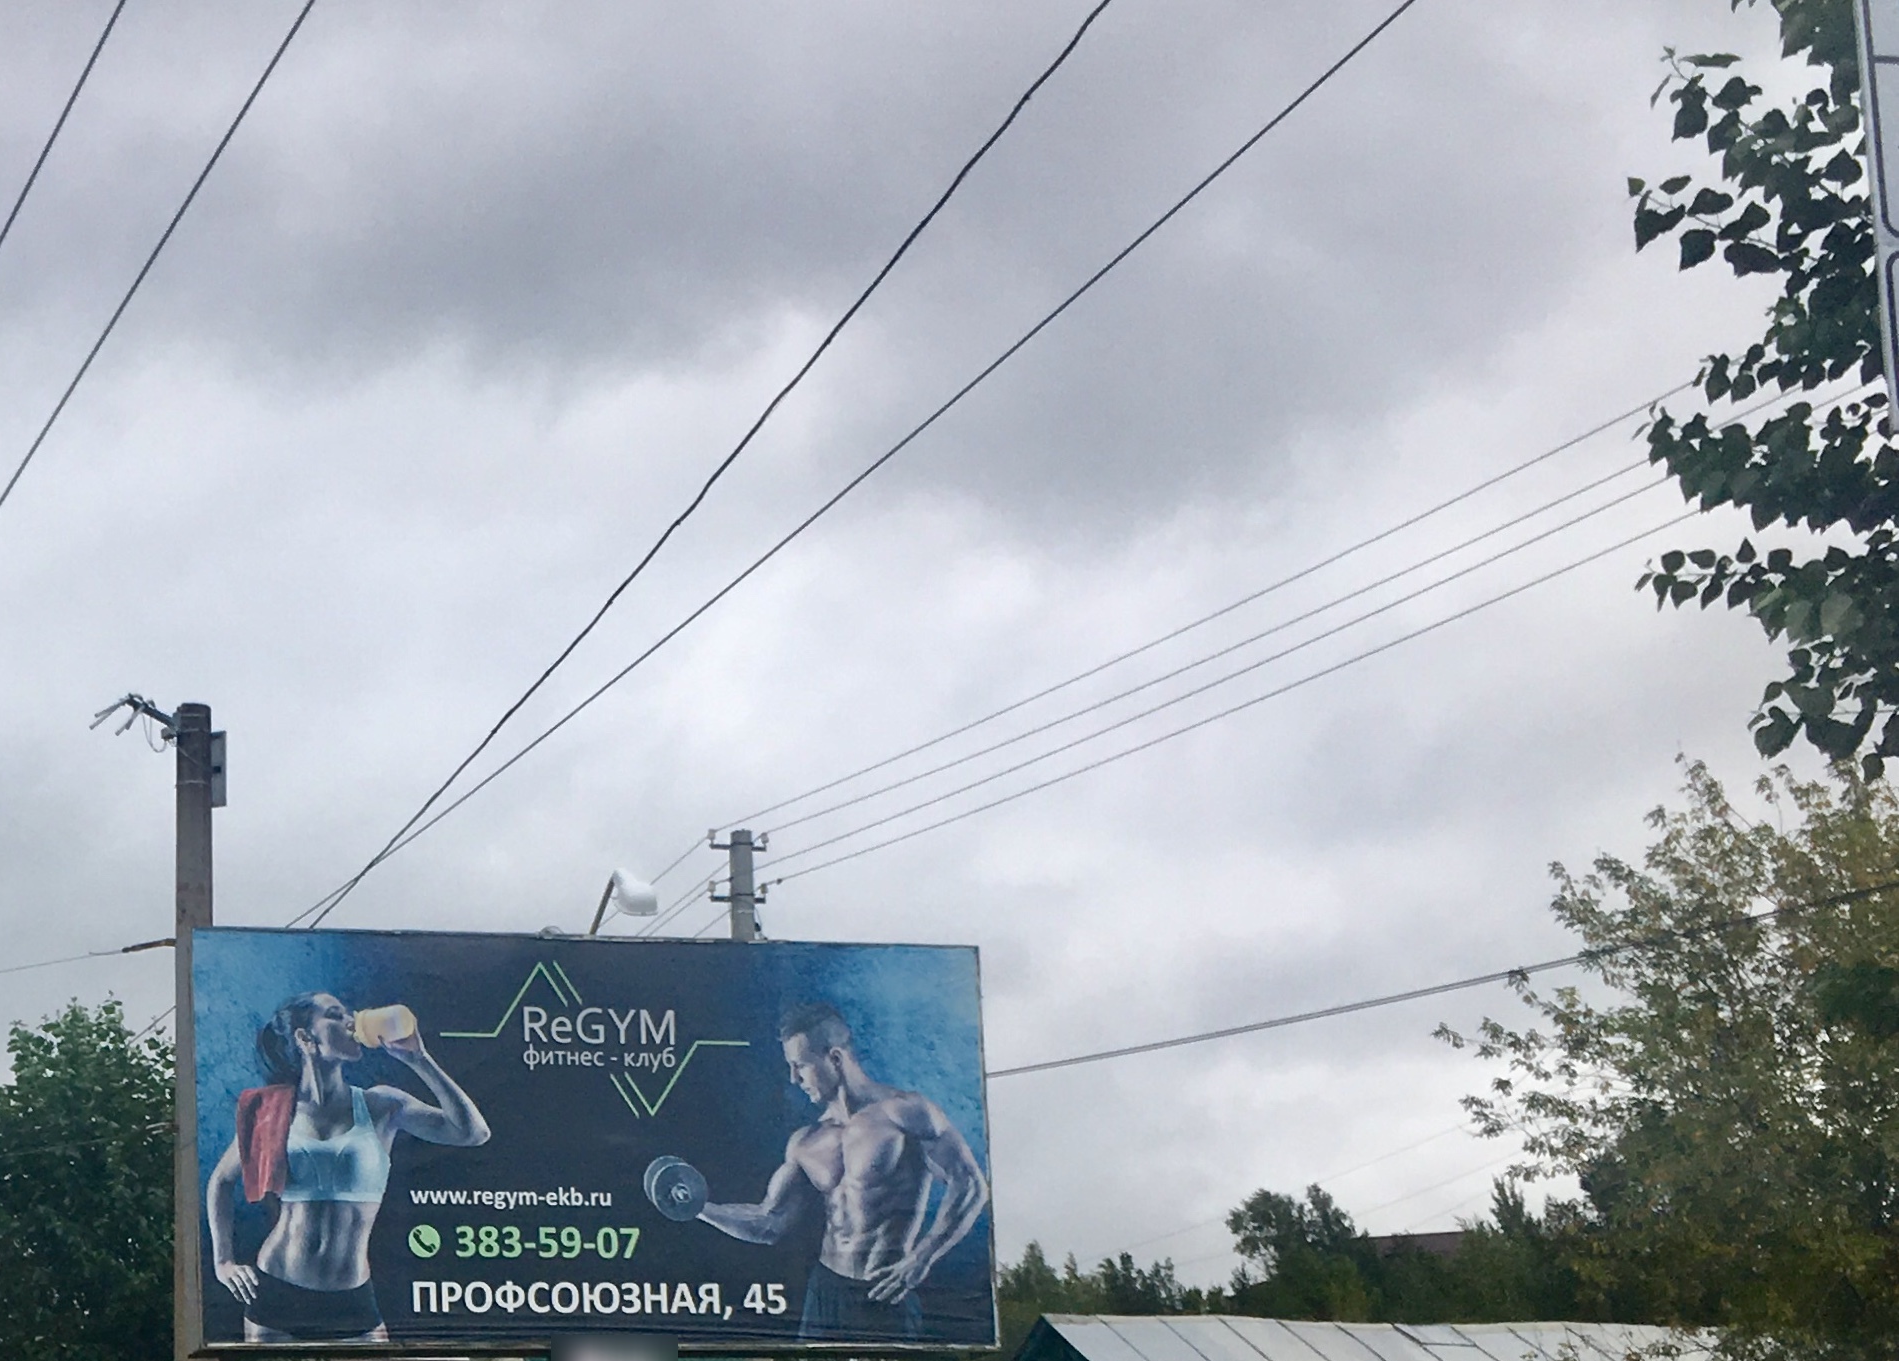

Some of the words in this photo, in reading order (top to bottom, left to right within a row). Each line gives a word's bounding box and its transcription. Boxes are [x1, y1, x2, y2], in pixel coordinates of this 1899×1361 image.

[522, 1006, 676, 1045] ReGYM
[522, 1043, 605, 1071] фитнес
[623, 1047, 676, 1074] клуб
[410, 1187, 612, 1209] www.regym-ekb.ru
[455, 1226, 641, 1259] 383-59-07
[412, 1280, 733, 1320] ПРОФСОЮЗНАЯ,
[743, 1283, 787, 1314] 45
